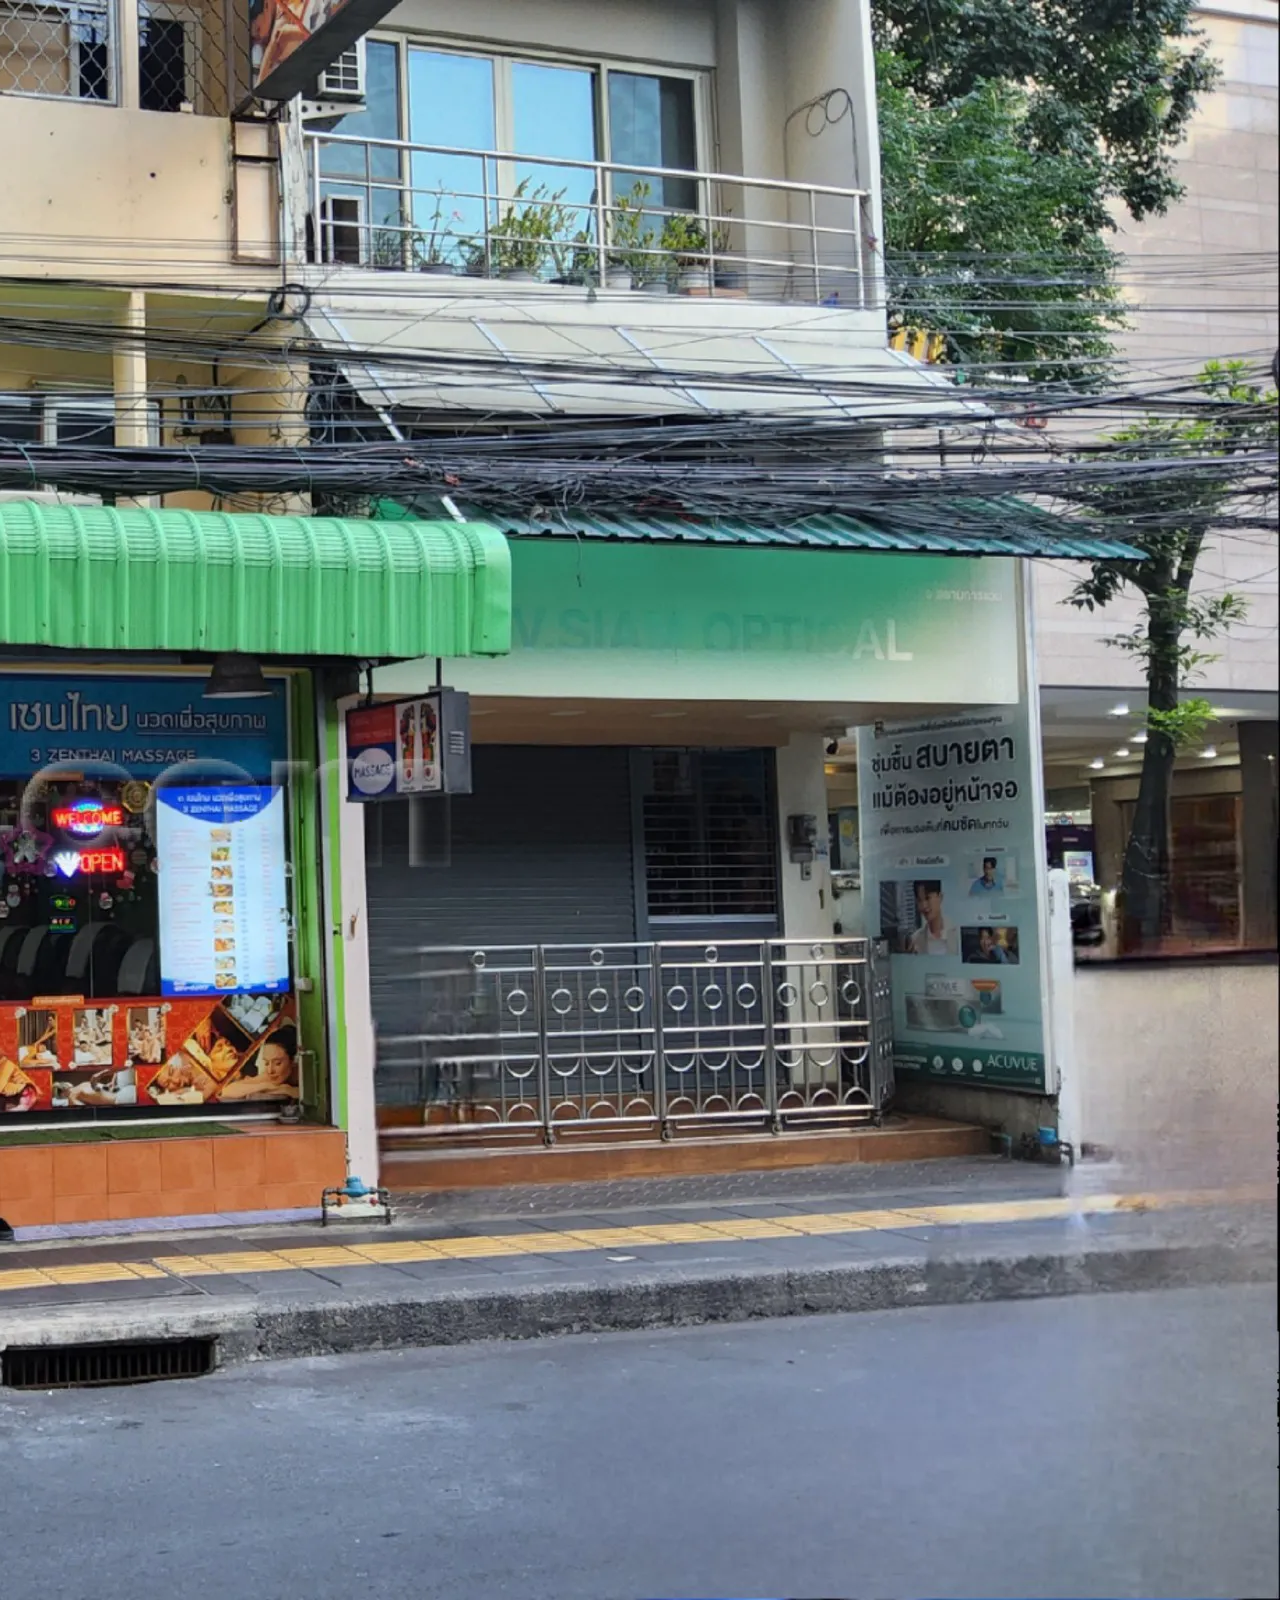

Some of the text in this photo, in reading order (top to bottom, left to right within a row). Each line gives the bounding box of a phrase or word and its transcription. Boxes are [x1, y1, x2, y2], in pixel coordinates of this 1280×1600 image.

[10, 691, 129, 732] เซนไทย
[30, 748, 197, 763] 3 ZENTHAI MASSAGE
[871, 736, 1014, 779] ชุ่มชื้น สบายตา
[872, 776, 1018, 812] แม้ต้องอยู่หน้าจอ
[55, 809, 123, 827] WELCOME
[80, 852, 124, 873] OPEN
[986, 1053, 1039, 1072] ACUVUE
